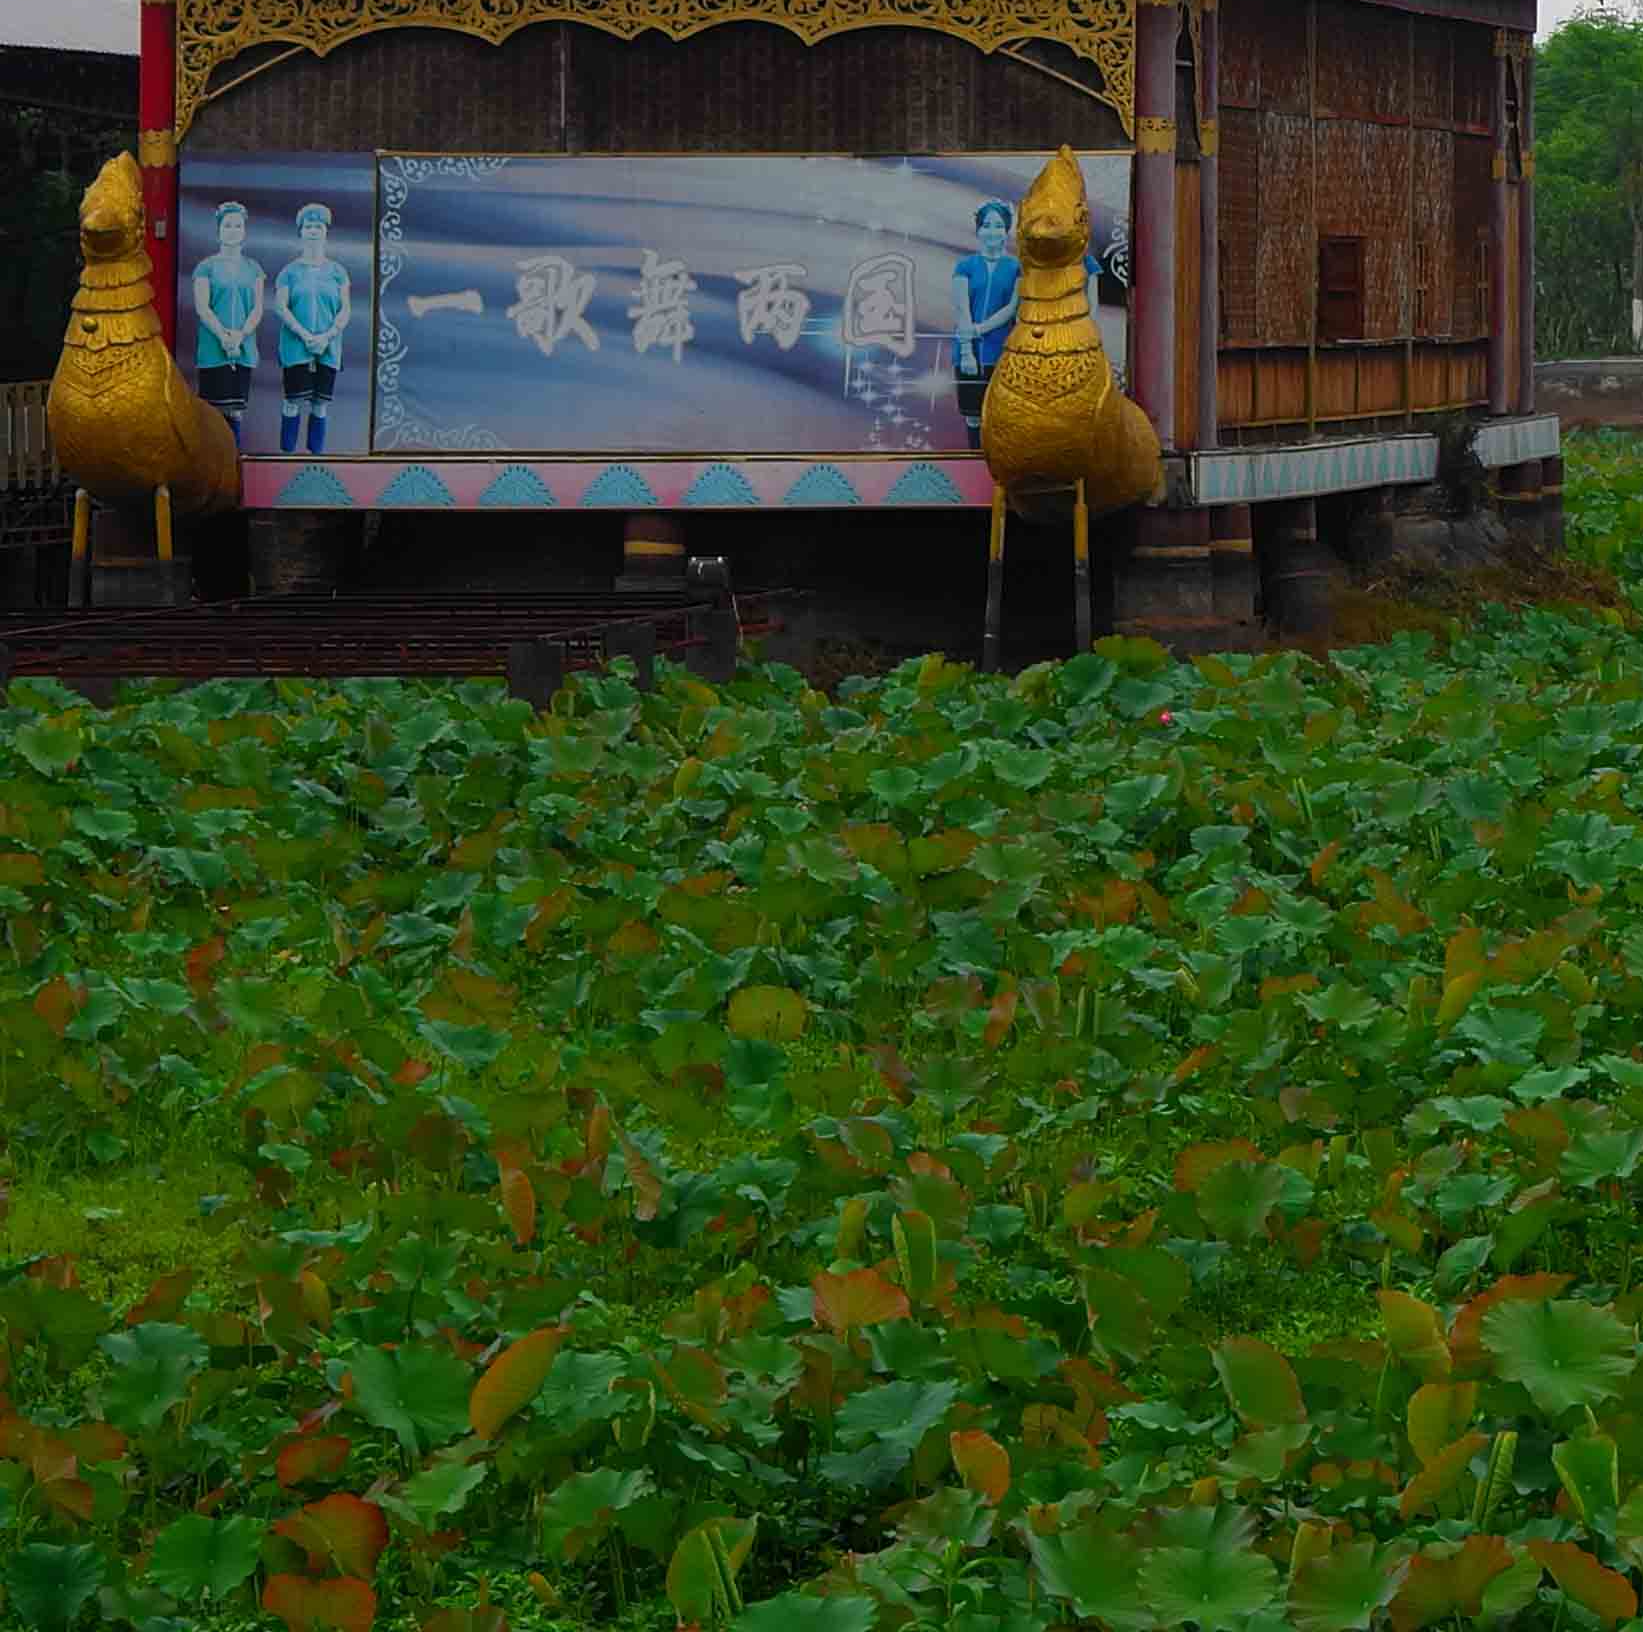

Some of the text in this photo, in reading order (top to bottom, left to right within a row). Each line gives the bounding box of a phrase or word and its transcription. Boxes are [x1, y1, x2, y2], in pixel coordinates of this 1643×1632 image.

[406, 247, 917, 365] 一歌舞两国
